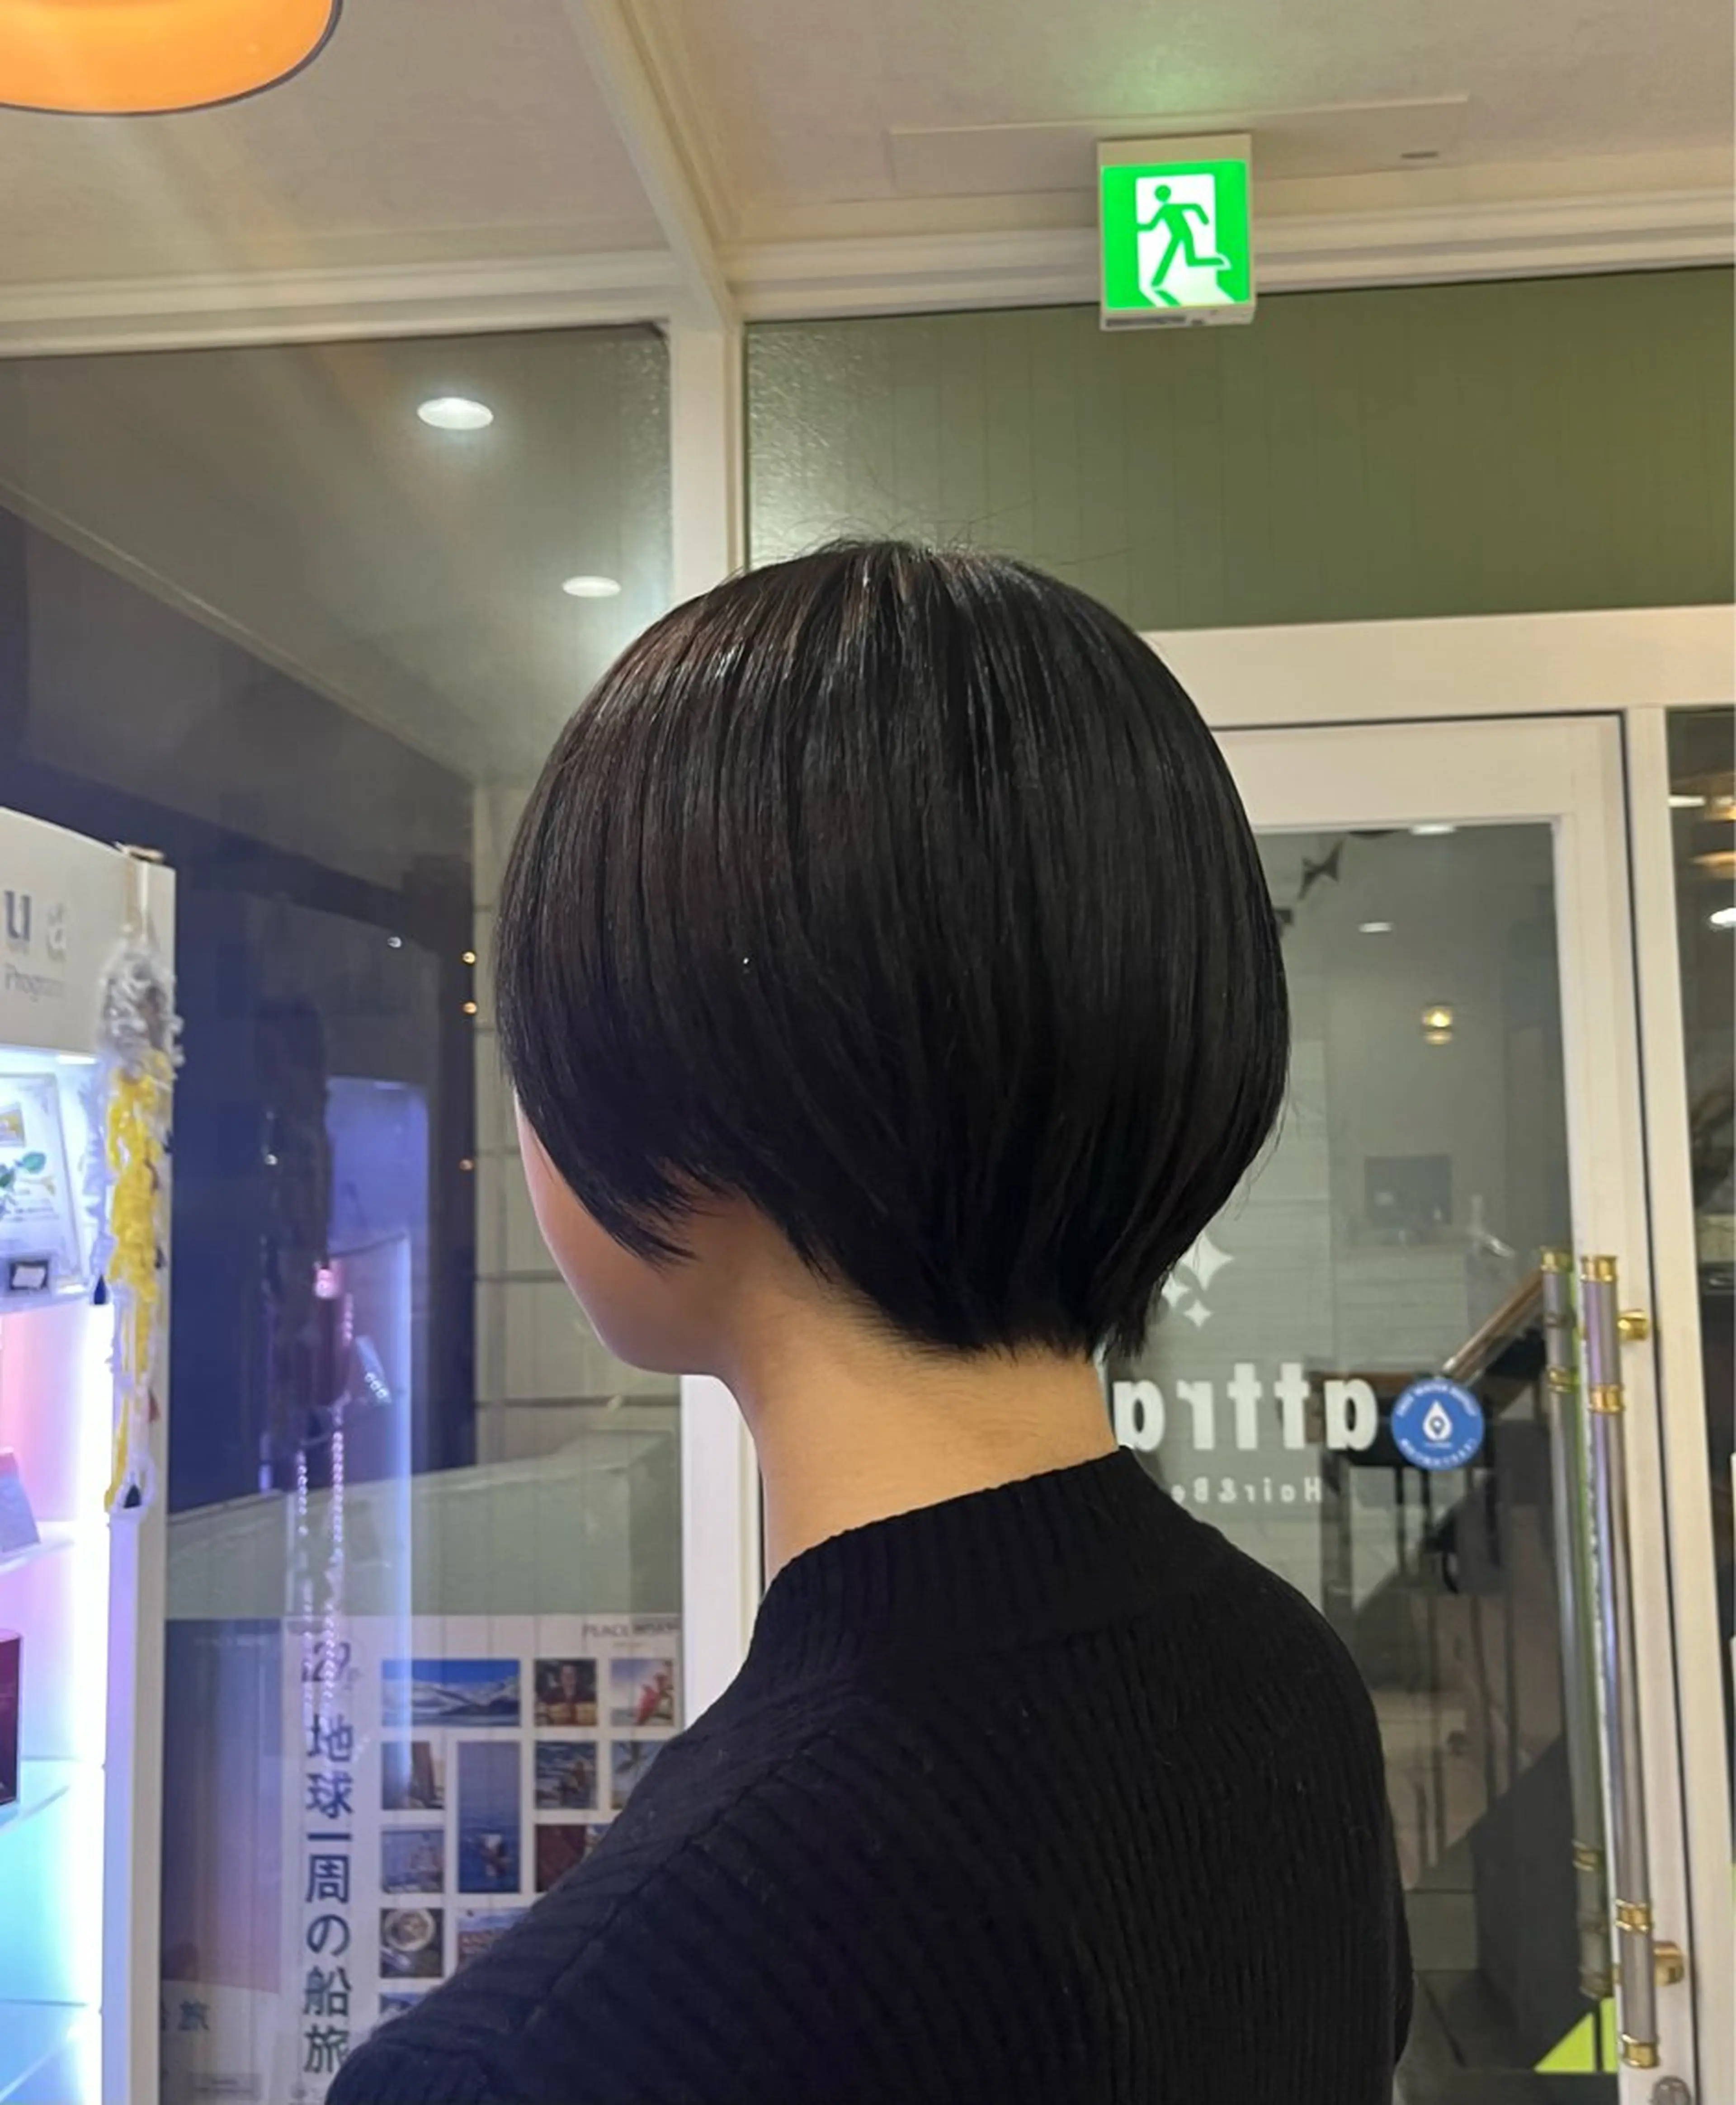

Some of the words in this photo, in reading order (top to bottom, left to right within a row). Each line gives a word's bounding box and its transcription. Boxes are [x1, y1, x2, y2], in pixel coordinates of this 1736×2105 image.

[303, 1710, 353, 2074] 地球一周の船旅
